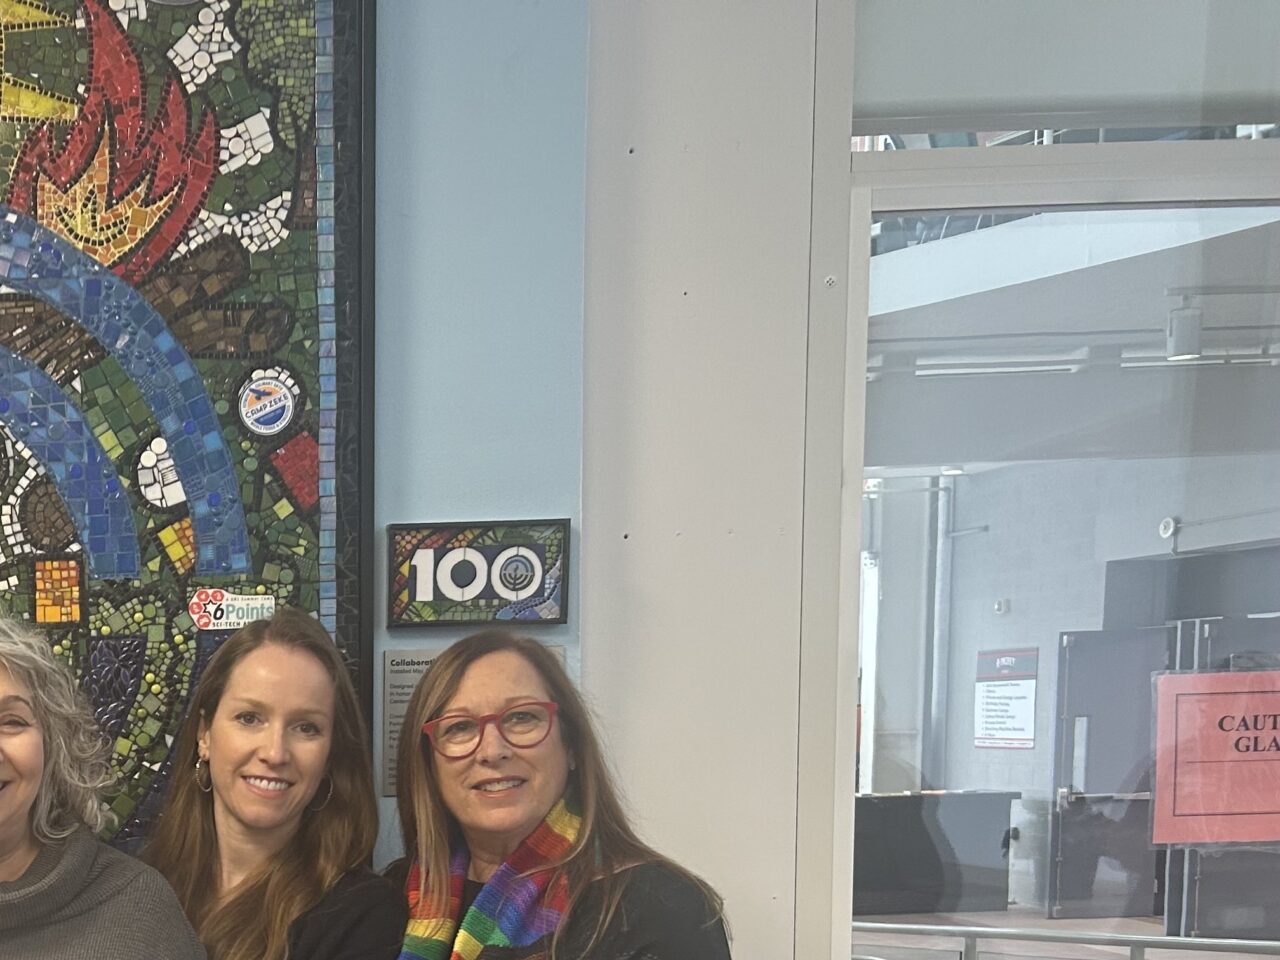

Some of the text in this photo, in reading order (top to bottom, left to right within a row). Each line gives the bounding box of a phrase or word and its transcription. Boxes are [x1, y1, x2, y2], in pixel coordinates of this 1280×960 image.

[245, 404, 268, 419] CAMP
[267, 393, 289, 408] ZEKE
[410, 546, 543, 602] 100
